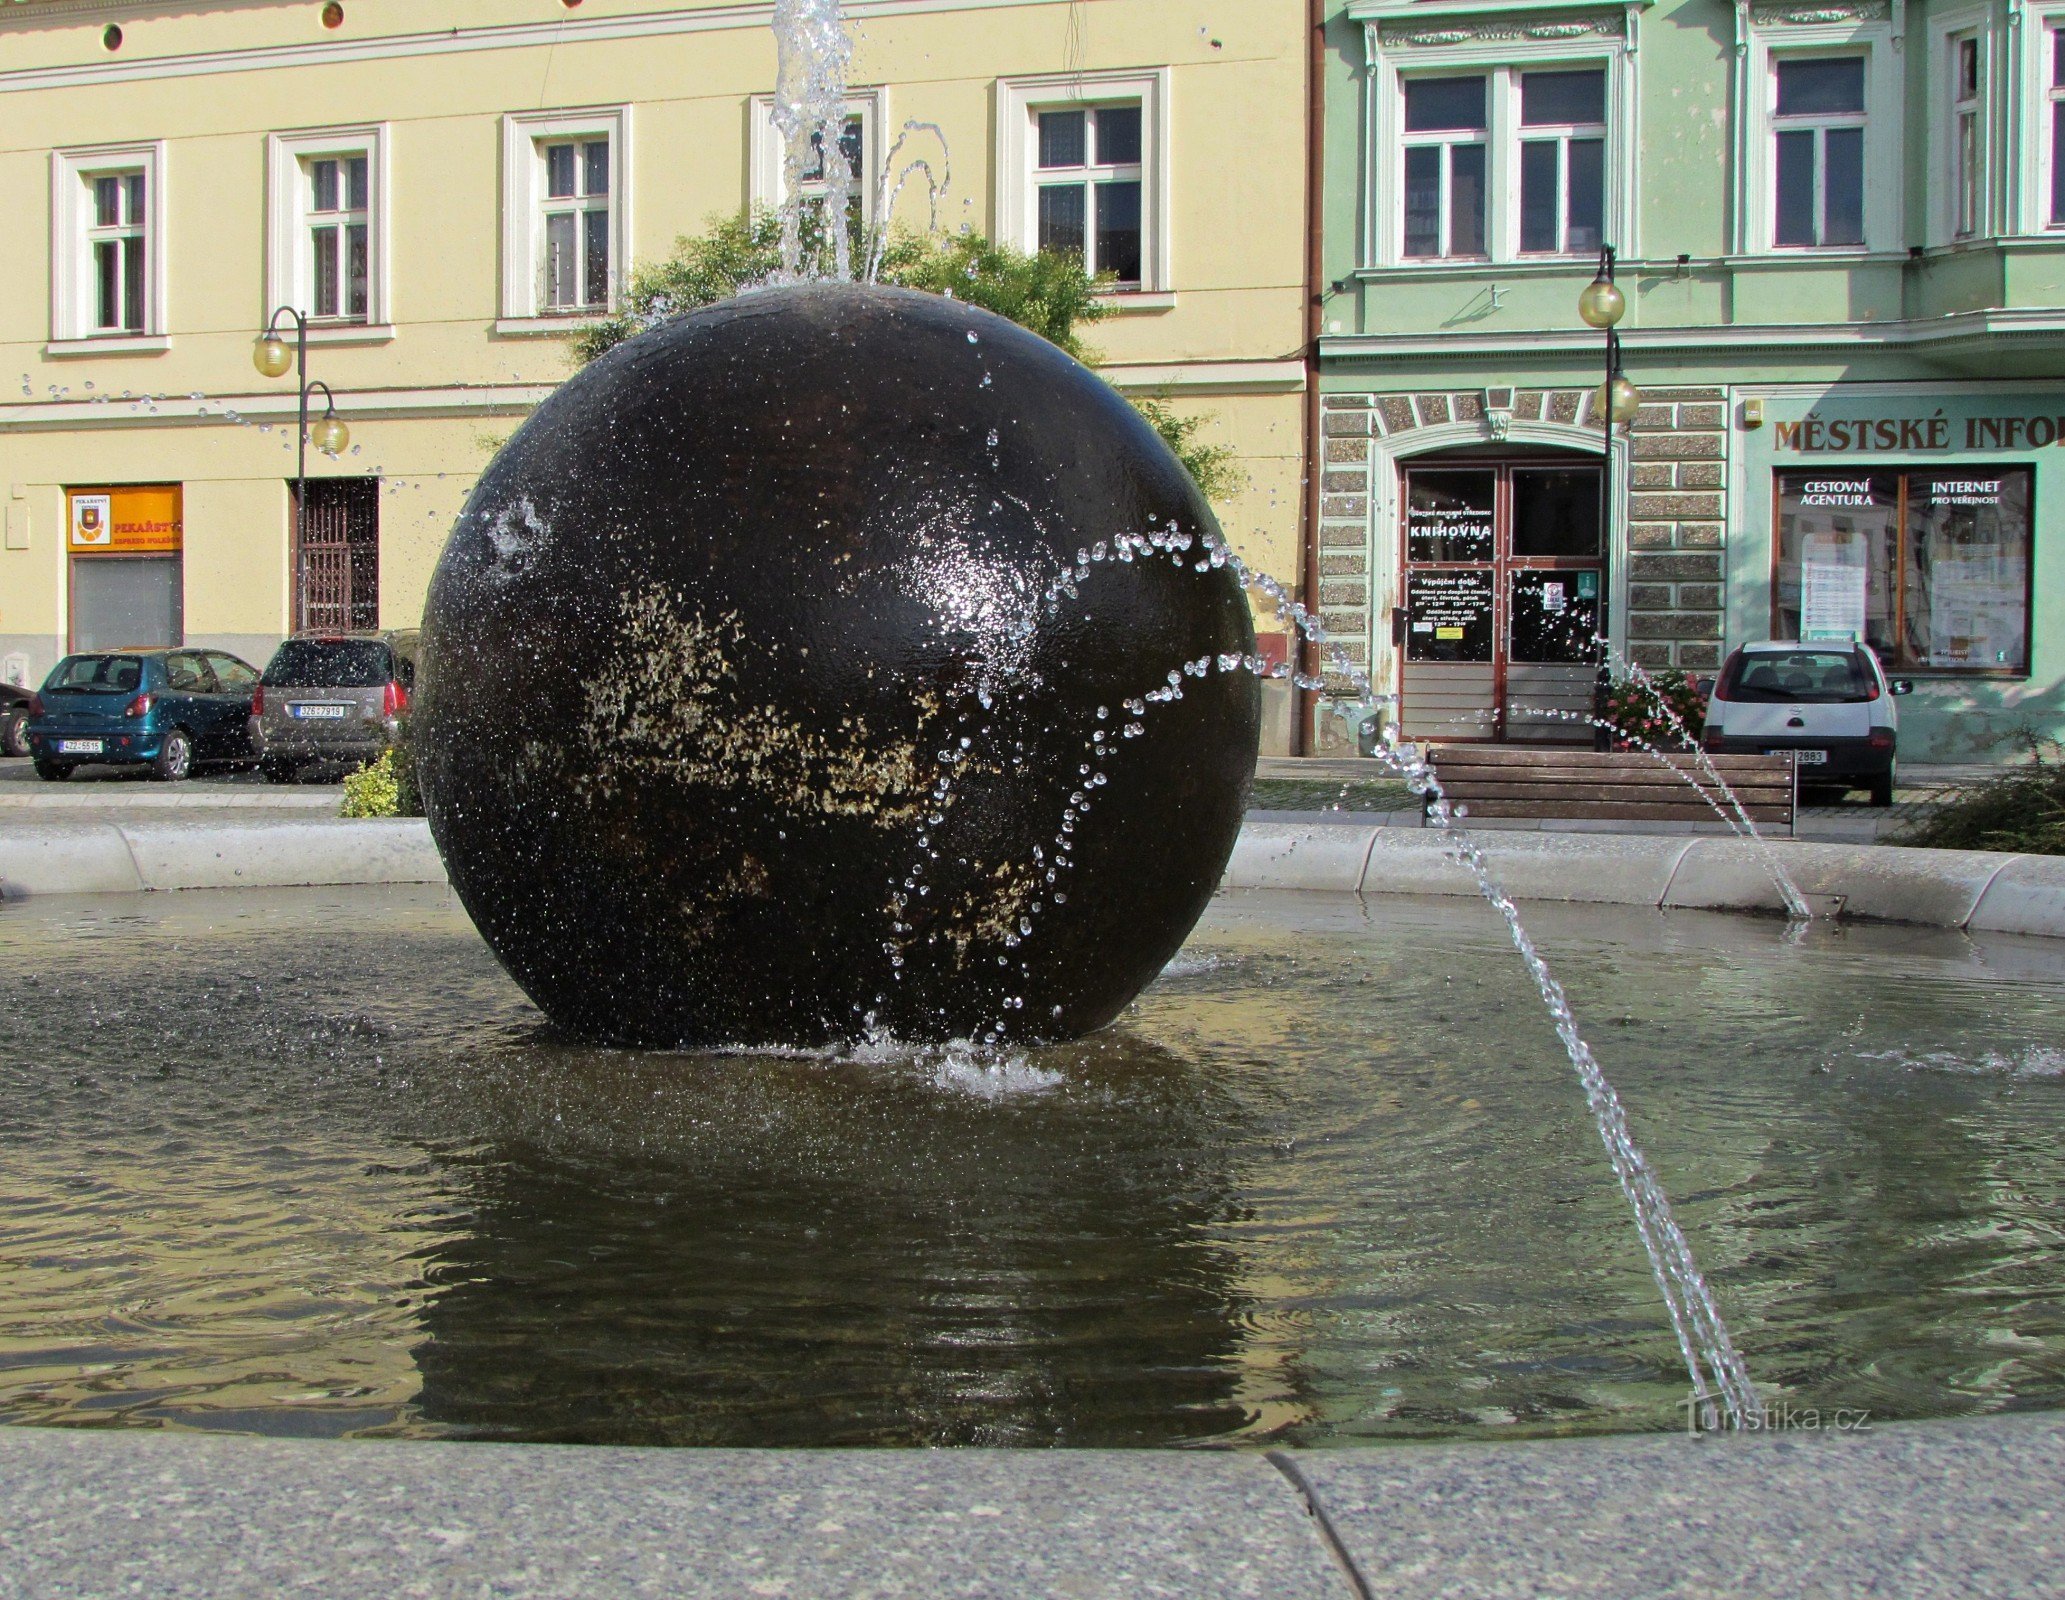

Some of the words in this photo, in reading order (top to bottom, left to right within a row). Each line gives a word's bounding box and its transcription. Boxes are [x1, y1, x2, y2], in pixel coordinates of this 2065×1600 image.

[1773, 408, 1949, 451] MĚSTSKÉ
[1804, 478, 1871, 493] CESTOVNÍ
[1932, 480, 2001, 494] INTERNET
[1800, 494, 1873, 506] AGENTURA
[1931, 497, 1949, 505] PRO
[1952, 495, 1999, 506] VEŘEJNOST
[1410, 525, 1491, 537] KNIHOVNA
[1798, 751, 1822, 762] 2883
